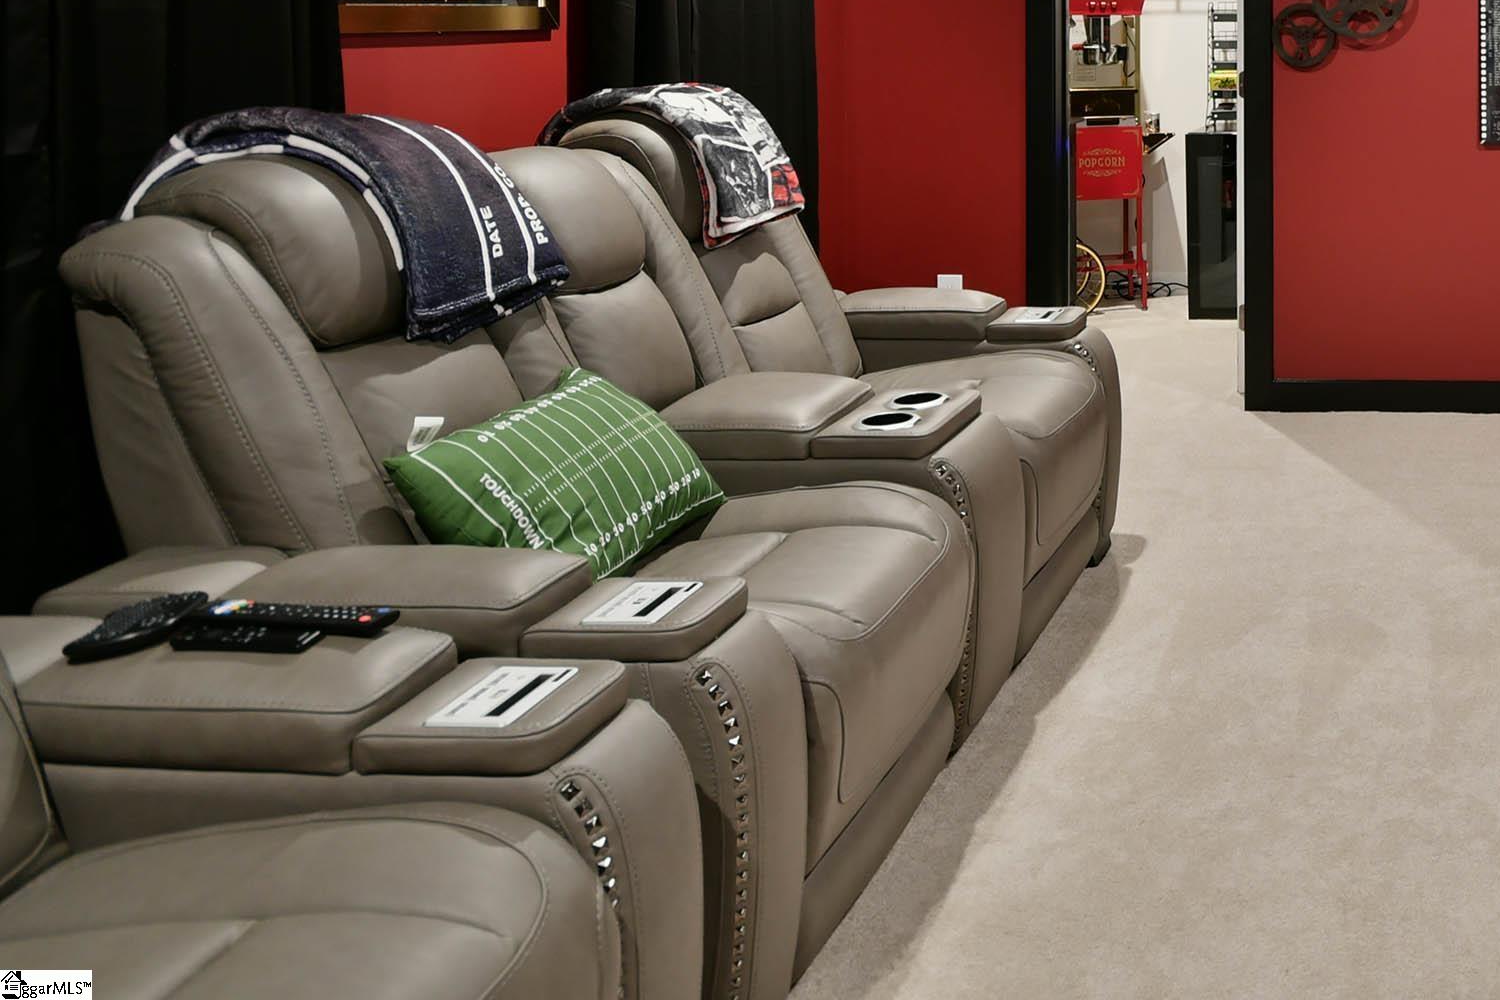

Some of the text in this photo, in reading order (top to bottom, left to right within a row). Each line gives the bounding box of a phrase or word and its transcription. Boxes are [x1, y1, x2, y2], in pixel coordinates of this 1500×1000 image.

[1079, 156, 1126, 168] POPCORN
[479, 205, 504, 259] DATE
[478, 471, 545, 551] TOUCHDOWN
[613, 523, 625, 537] 30
